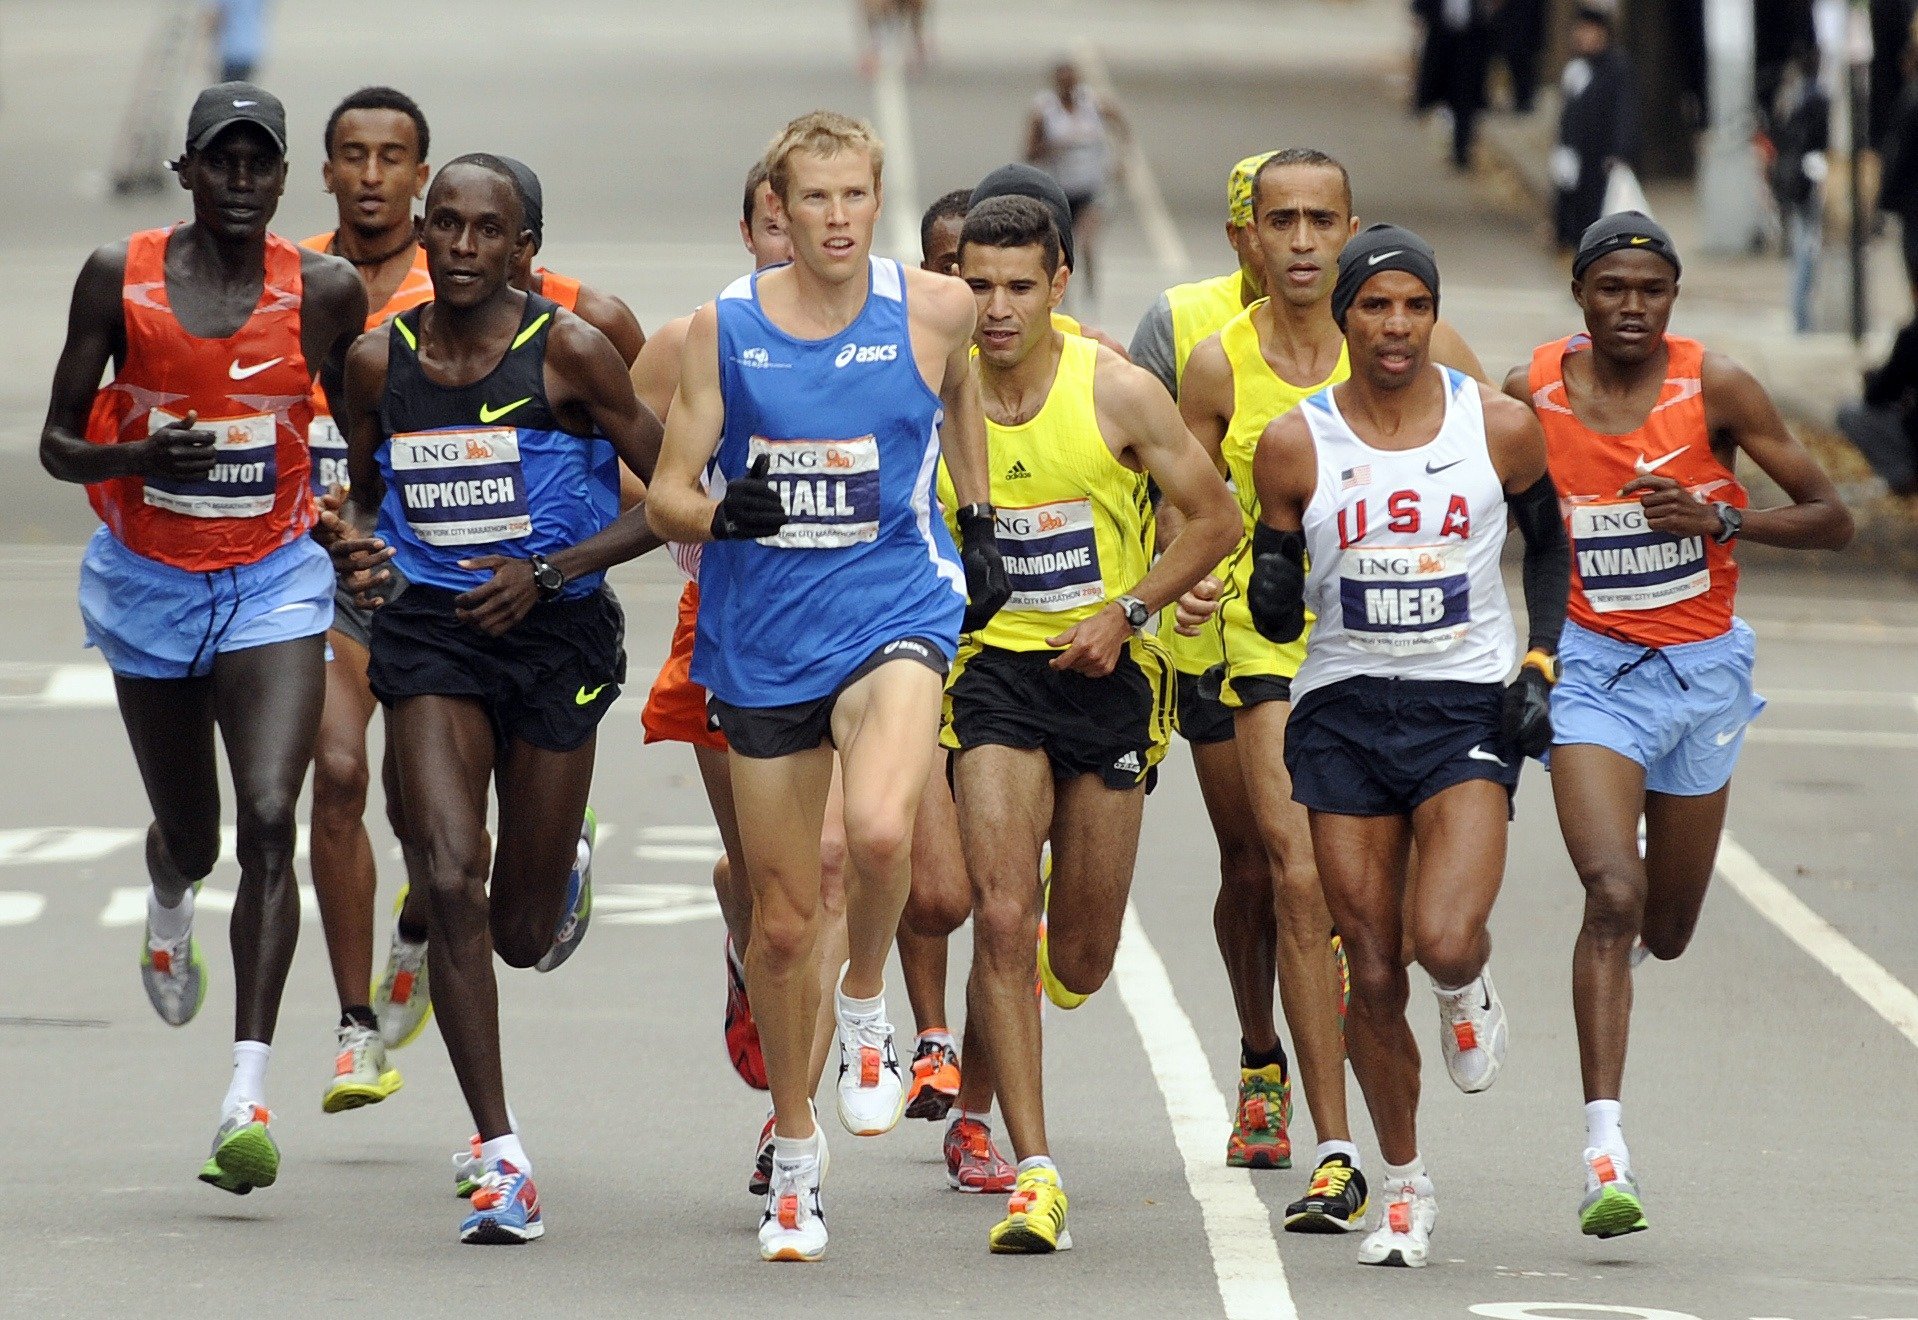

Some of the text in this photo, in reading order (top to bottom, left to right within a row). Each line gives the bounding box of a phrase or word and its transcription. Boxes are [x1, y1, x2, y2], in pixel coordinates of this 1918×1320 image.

[855, 344, 898, 363] asics
[410, 443, 459, 463] ING
[776, 451, 817, 467] NG
[1005, 472, 1031, 481] adidas
[404, 476, 515, 509] KIPKOECH
[995, 517, 1031, 535] NG
[1337, 489, 1471, 551] USA
[1590, 510, 1642, 532] ING
[451, 526, 466, 536] CITY
[467, 525, 507, 535] MARATHON
[1577, 535, 1704, 577] KWAMBAI
[1357, 557, 1409, 575] ING
[1024, 596, 1039, 605] CITY
[1040, 589, 1080, 604] MARATHON
[1651, 583, 1690, 598] MARATHON
[1365, 587, 1444, 626] MEB
